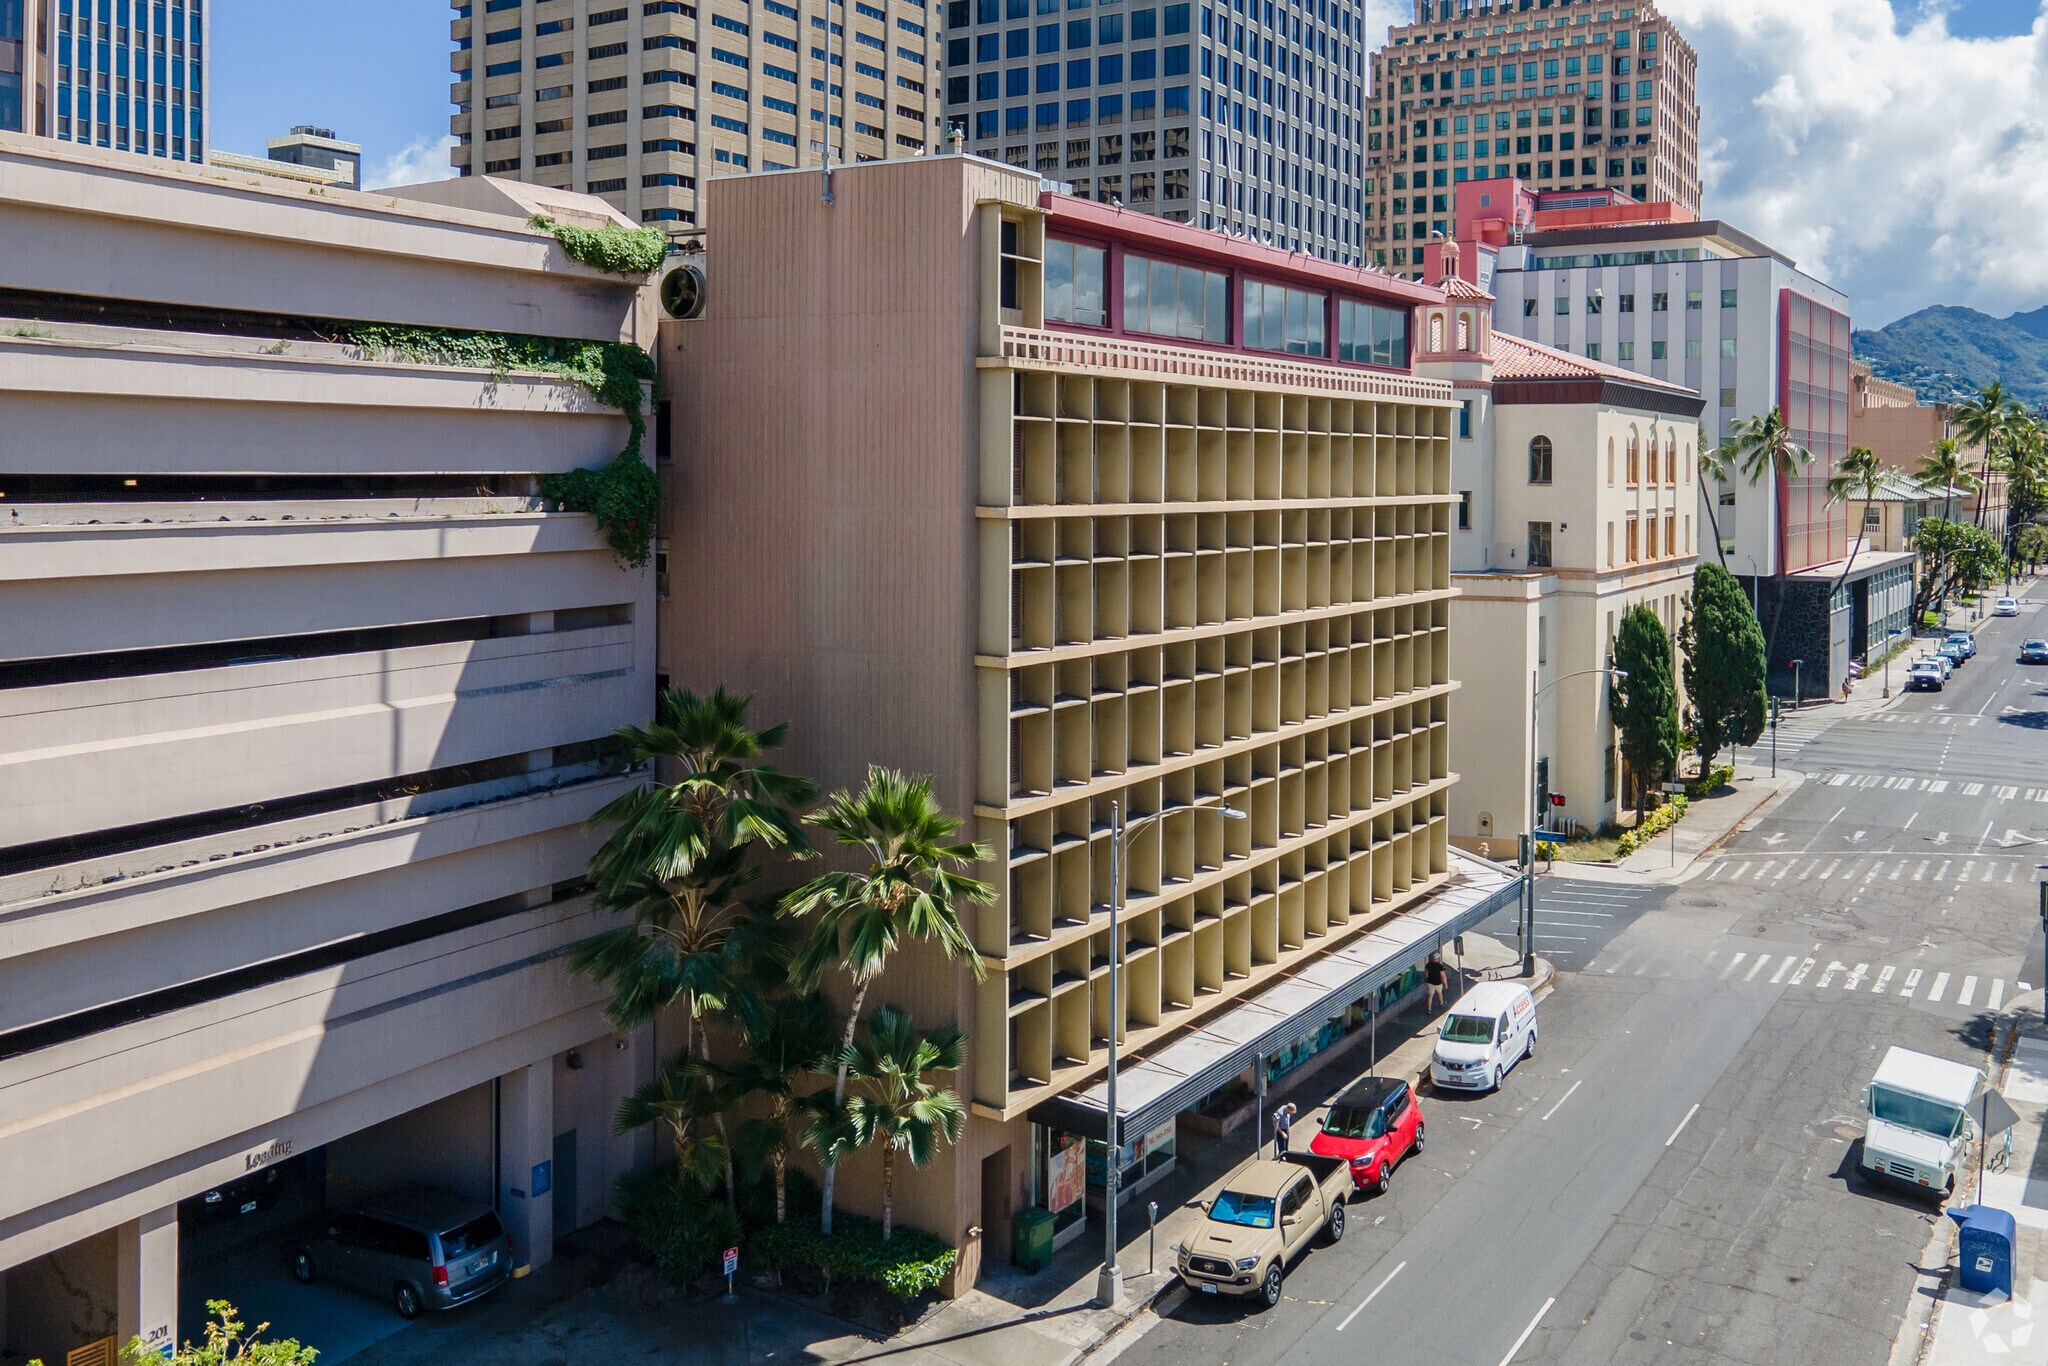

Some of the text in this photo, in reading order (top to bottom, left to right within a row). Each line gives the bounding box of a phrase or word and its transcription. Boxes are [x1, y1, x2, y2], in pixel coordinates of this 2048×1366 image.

[1512, 996, 1530, 1018] Access
[245, 1140, 292, 1171] Loading
[148, 1324, 168, 1344] 201
